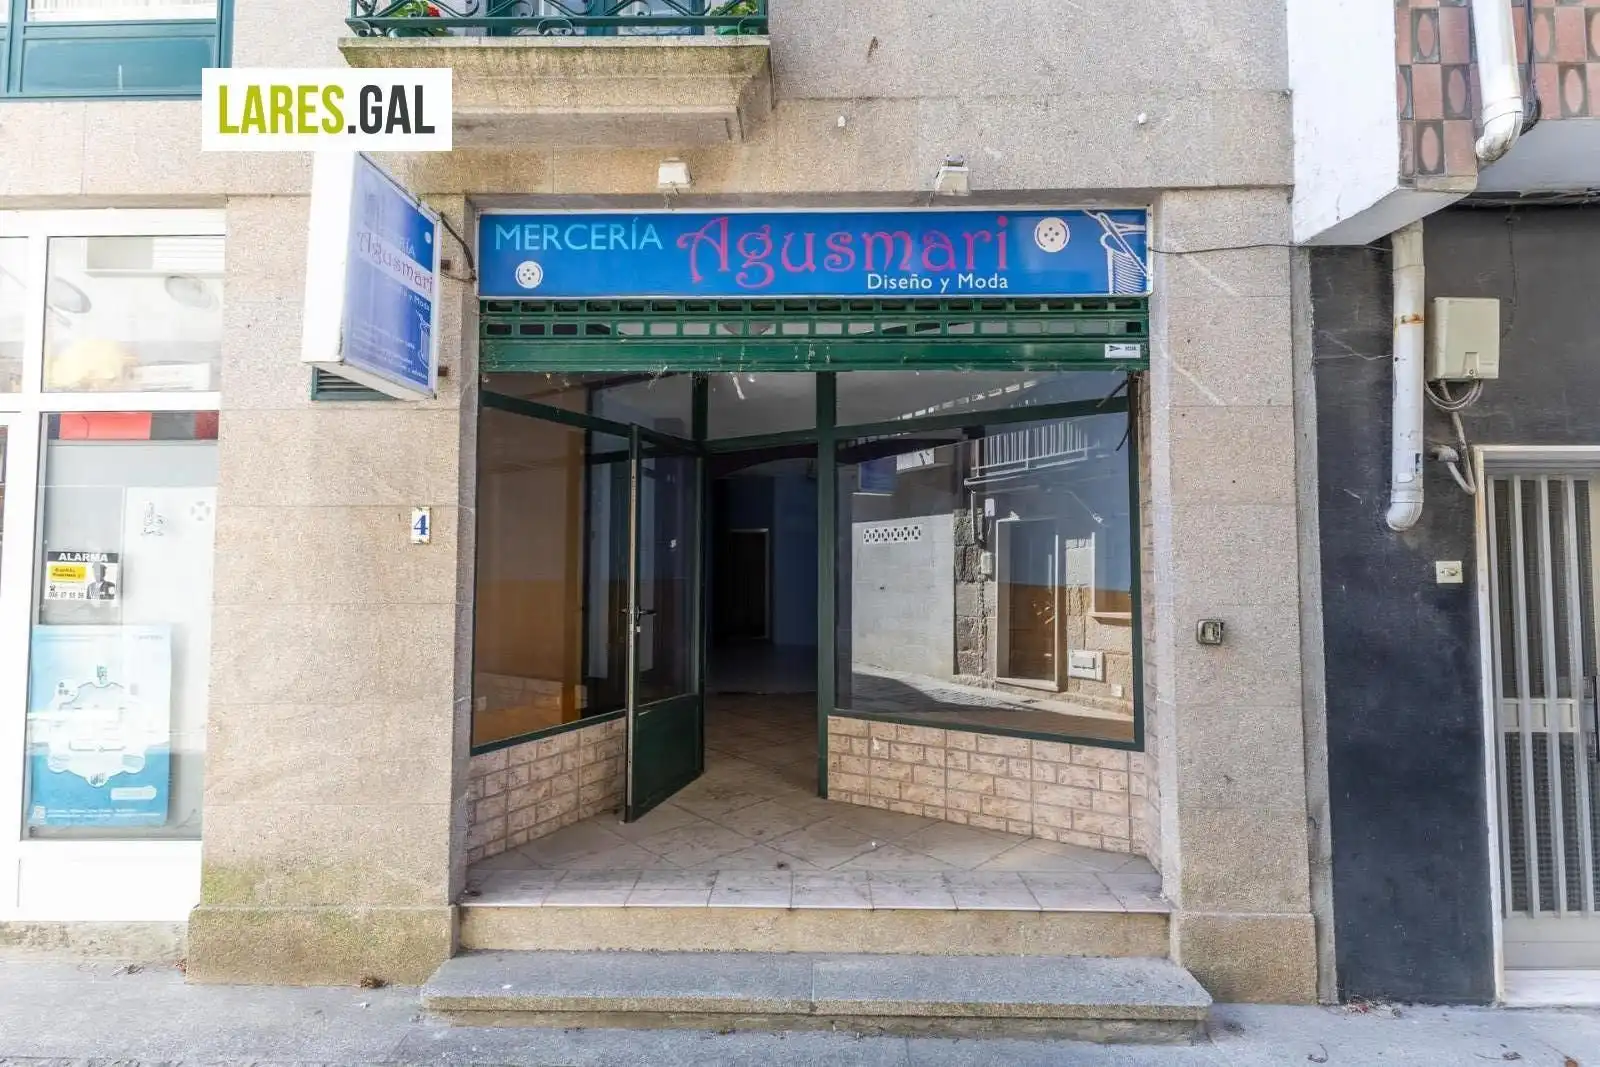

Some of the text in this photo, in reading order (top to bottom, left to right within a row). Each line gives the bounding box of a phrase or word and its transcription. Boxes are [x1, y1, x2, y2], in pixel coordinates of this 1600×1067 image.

[357, 231, 433, 292] Agusmari
[495, 215, 1008, 289] MERCERÍA Agusmari
[867, 273, 1009, 294] Diseño y Moda
[413, 514, 429, 536] 4
[58, 552, 109, 563] ALARMA
